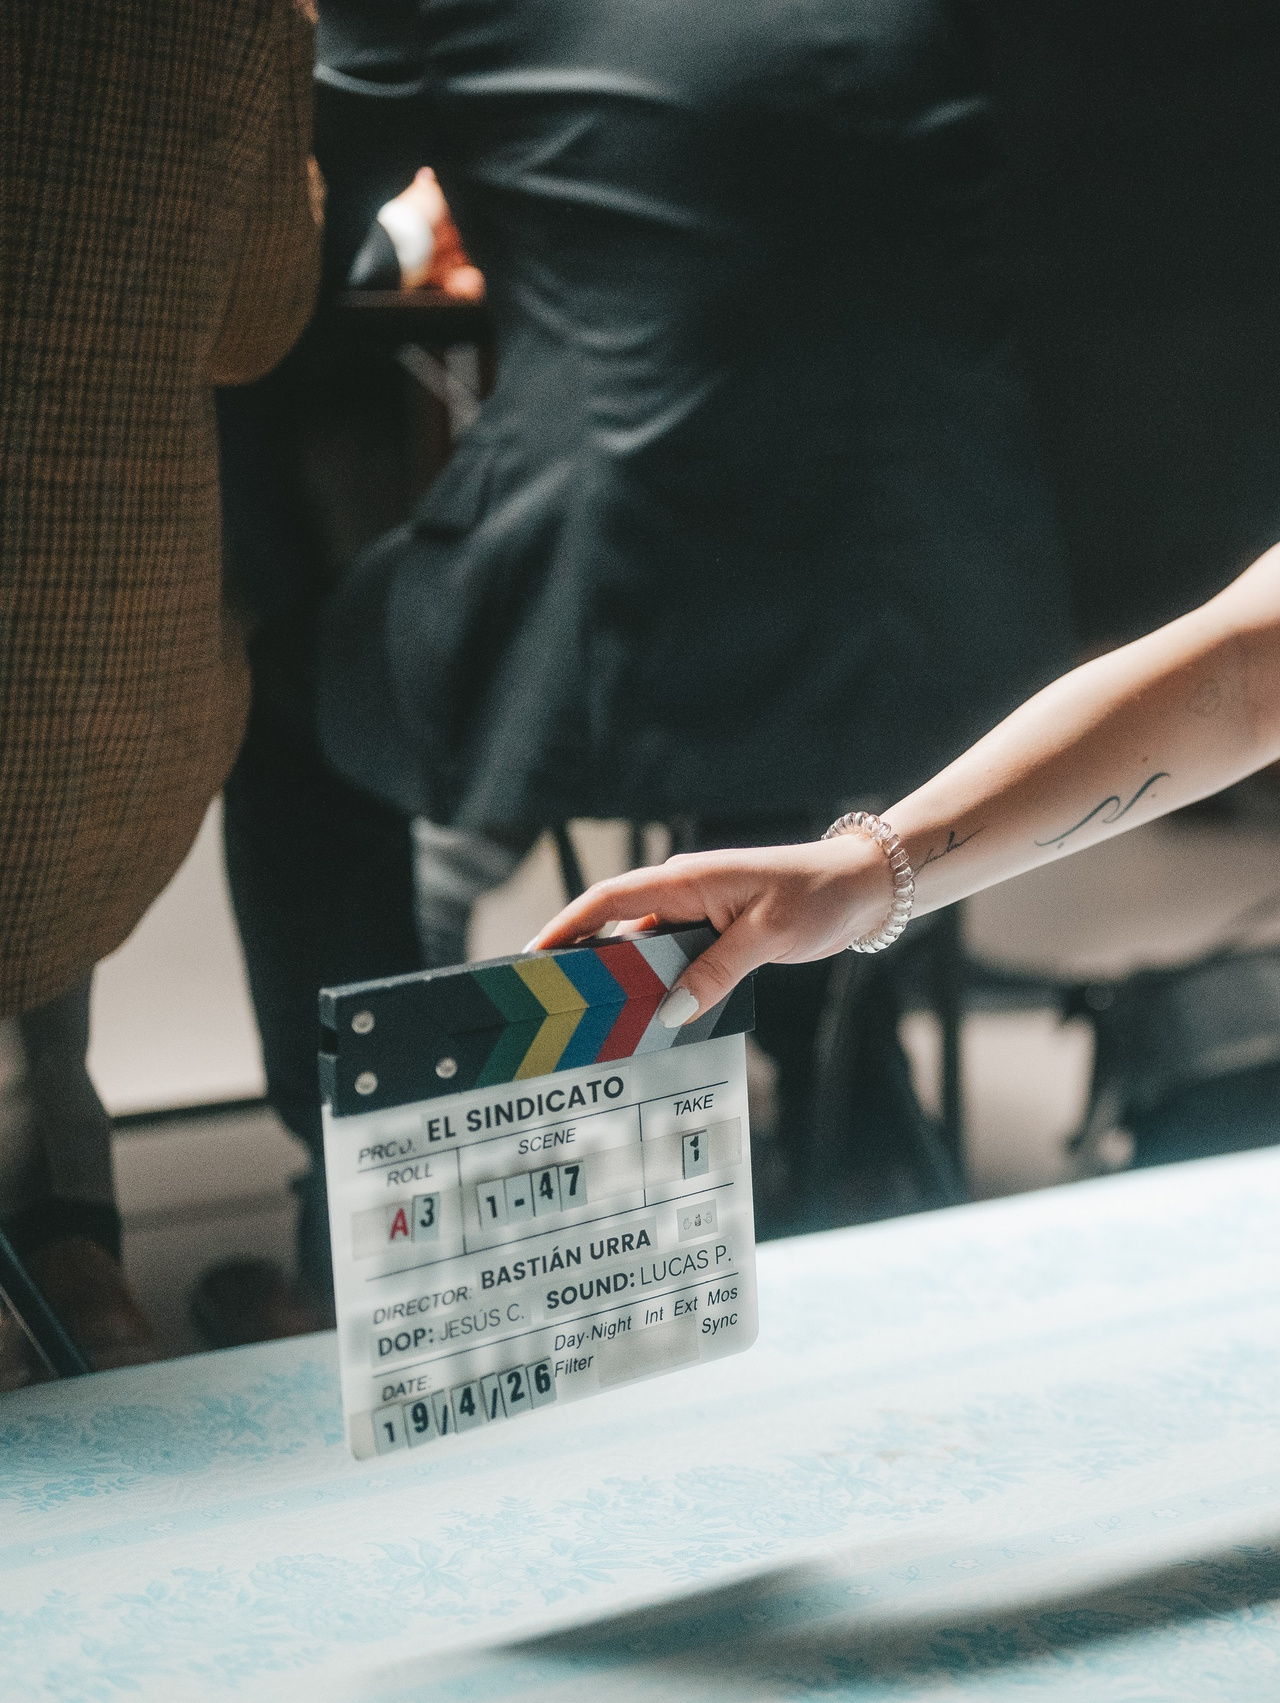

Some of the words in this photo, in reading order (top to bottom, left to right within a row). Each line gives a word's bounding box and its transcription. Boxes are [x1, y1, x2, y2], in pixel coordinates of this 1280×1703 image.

[427, 1116, 456, 1142] EL
[466, 1075, 624, 1132] SINDICATO
[674, 1093, 714, 1116] TAKE
[518, 1128, 577, 1155] SCENE
[690, 1135, 700, 1162] 1
[387, 1163, 433, 1187] ROLL
[486, 1165, 582, 1218] 1-47
[481, 1246, 582, 1290] BASTIÁN
[589, 1229, 651, 1261] URRA
[546, 1271, 635, 1309] SOUND:
[640, 1249, 709, 1285] LUCAS
[715, 1244, 732, 1269] P.
[645, 1307, 664, 1325] Int
[674, 1296, 699, 1317] Ext
[707, 1285, 738, 1307] Mos
[378, 1328, 434, 1357] DOP:
[440, 1309, 501, 1342] JESÚS
[506, 1303, 525, 1323] C.
[701, 1311, 738, 1336] Sync
[554, 1355, 594, 1378] Filter
